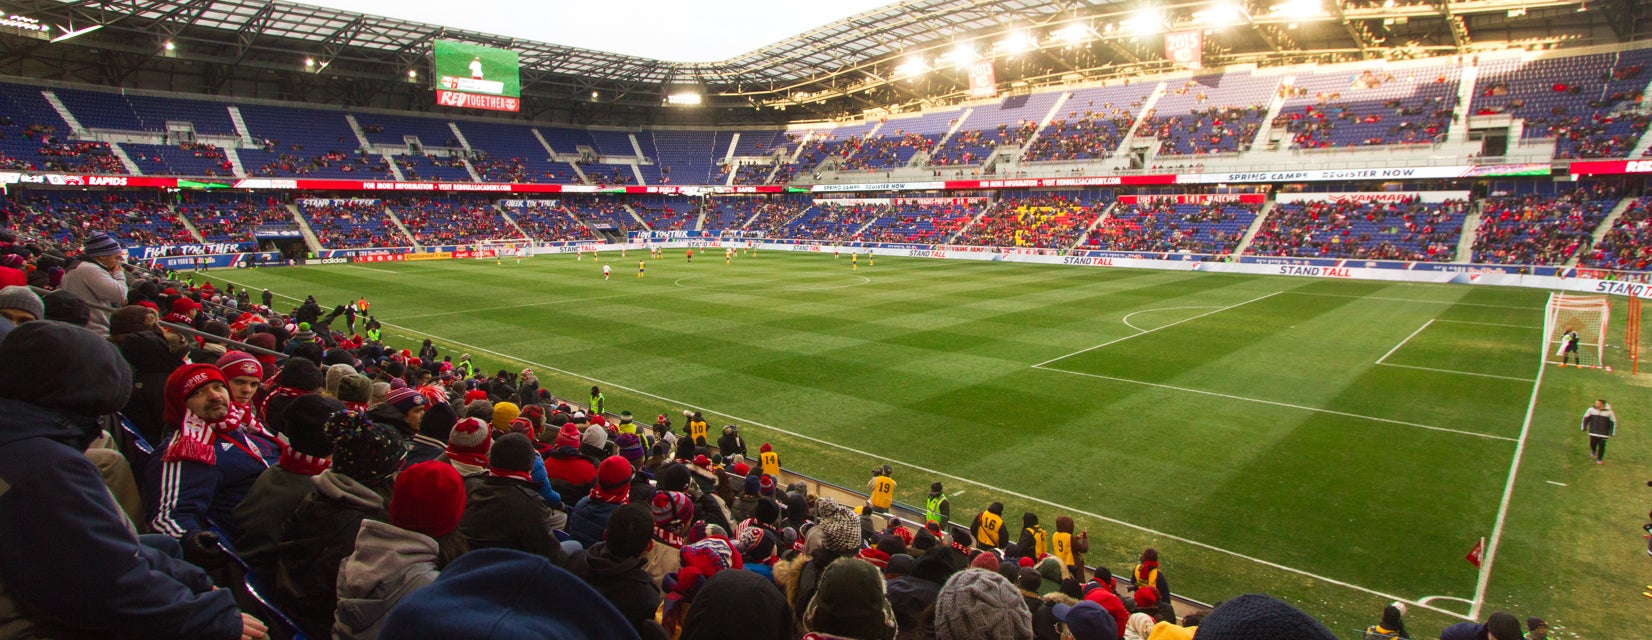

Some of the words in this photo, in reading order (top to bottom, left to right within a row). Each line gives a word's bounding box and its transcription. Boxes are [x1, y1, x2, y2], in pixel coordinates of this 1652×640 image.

[1168, 32, 1198, 51] 2015
[970, 62, 992, 77] 2013
[1382, 169, 1415, 177] NOW
[89, 177, 127, 186] RAPIDS
[363, 182, 375, 190] FOR
[376, 182, 394, 190] MORE
[395, 182, 433, 190] INFORMATION
[439, 182, 452, 191] VISIT
[1056, 177, 1121, 186] REDBULLSACADEMY.COM
[303, 199, 330, 207] STAND
[1136, 195, 1152, 204] LUIS
[1185, 194, 1200, 204] 141
[1206, 192, 1240, 202] MATCHES
[1350, 194, 1406, 202] YANMAR
[655, 231, 688, 239] TOGETHER
[144, 245, 176, 259] FIGHT
[581, 244, 596, 252] TALL
[930, 250, 946, 258] TALL
[1063, 256, 1092, 265] STAND
[1092, 257, 1114, 265] TALL
[1280, 265, 1320, 276] STAND
[1321, 267, 1351, 277] TALL
[1596, 281, 1643, 296] STAND
[694, 424, 703, 434] 10
[764, 455, 775, 465] 14
[878, 482, 891, 494] 19
[984, 517, 997, 532] 16
[1057, 540, 1064, 553] 9
